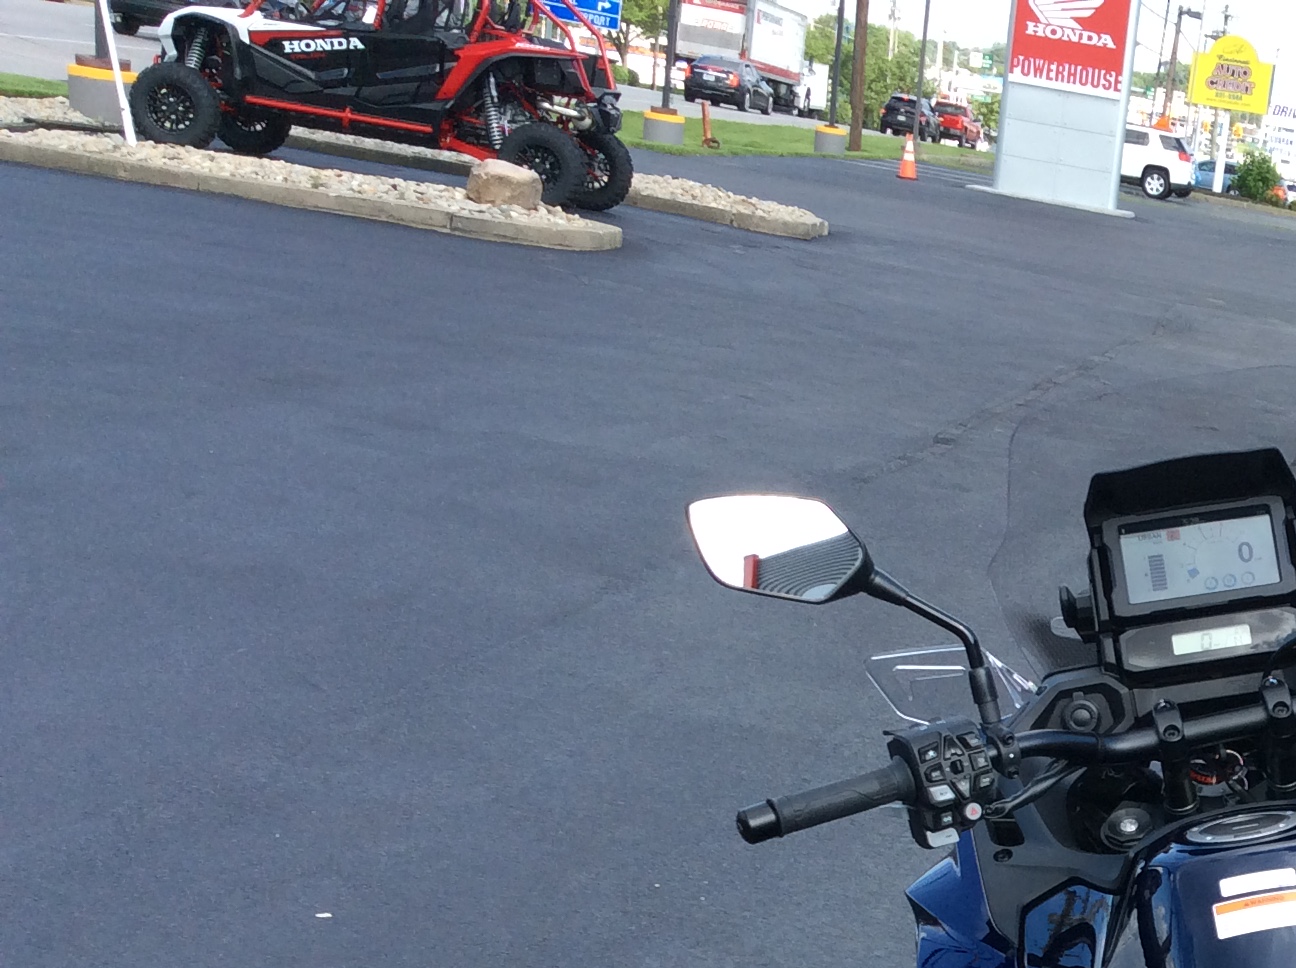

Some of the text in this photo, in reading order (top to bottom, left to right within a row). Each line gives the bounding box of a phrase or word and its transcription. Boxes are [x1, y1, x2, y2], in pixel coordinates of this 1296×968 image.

[282, 37, 366, 53] HONDA
[1025, 20, 1117, 49] HONDA
[1008, 56, 1123, 93] POWERHOUSE
[1212, 62, 1252, 80] AUTO
[1237, 541, 1254, 563] 0
